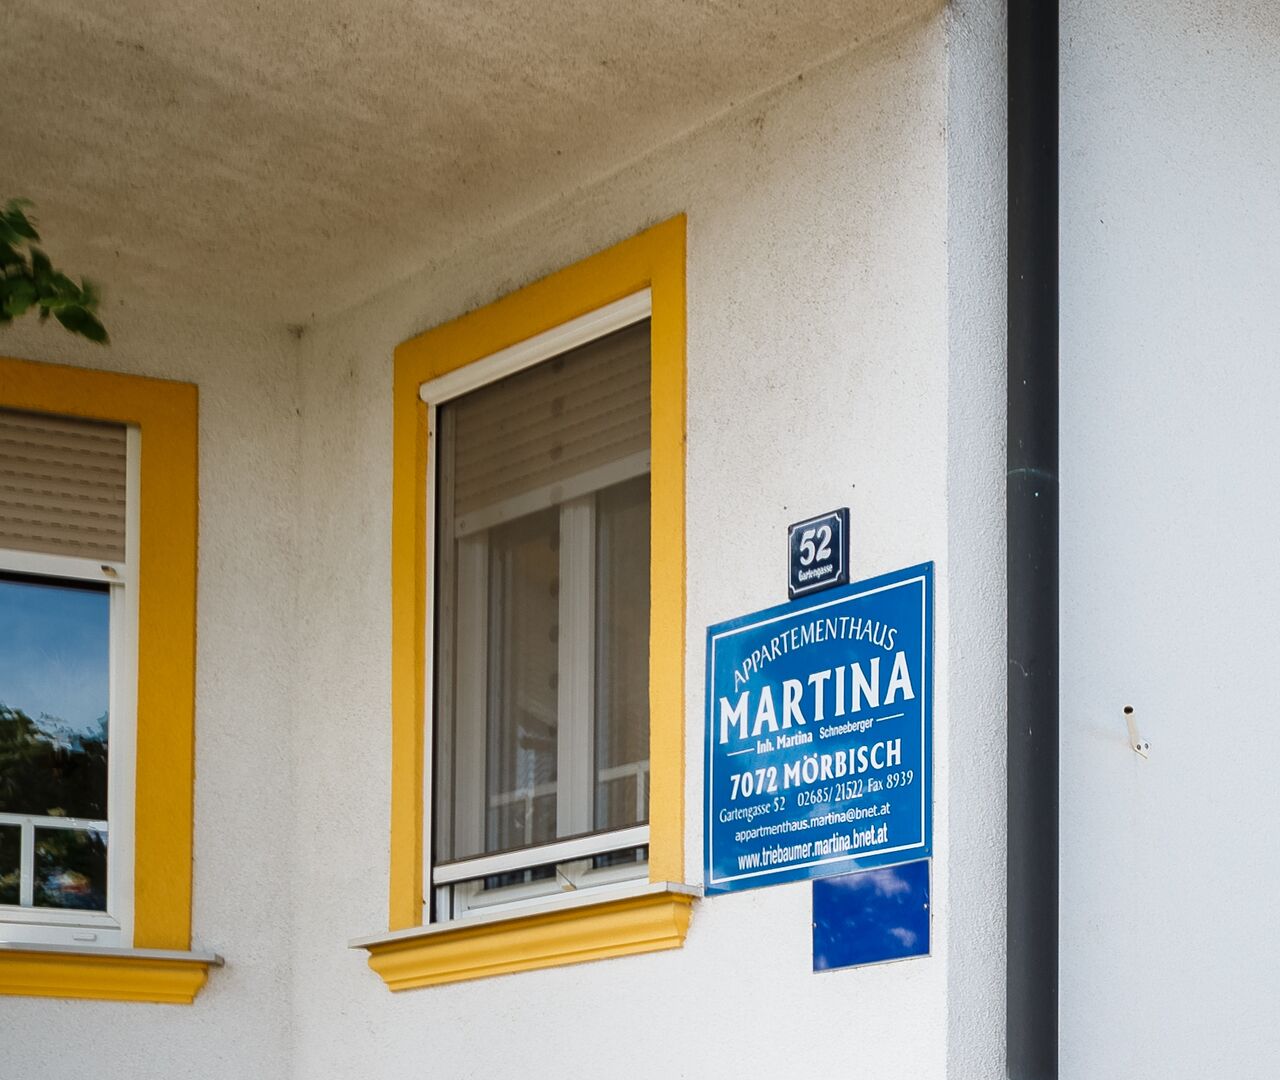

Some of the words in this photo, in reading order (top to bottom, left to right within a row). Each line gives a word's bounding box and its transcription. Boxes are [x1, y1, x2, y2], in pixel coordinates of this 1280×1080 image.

[800, 525, 832, 566] 52
[798, 563, 833, 581] Gartengasse
[733, 616, 898, 692] APPARTEMENTHAUS
[719, 650, 915, 744] MARTINA
[757, 736, 775, 754] Inh.
[777, 730, 813, 749] Martina
[819, 717, 873, 740] Schneeberger
[730, 766, 778, 801] 7072
[783, 738, 901, 789] MÖRBISCH
[719, 803, 770, 823] Gartengasse
[773, 796, 785, 812] 52
[867, 777, 884, 793] Fax
[886, 769, 914, 789] 8939
[735, 802, 891, 842] appartmenthaus.martina@bnet.at
[738, 822, 888, 871] www.triebaumer.martina.bnet.at
